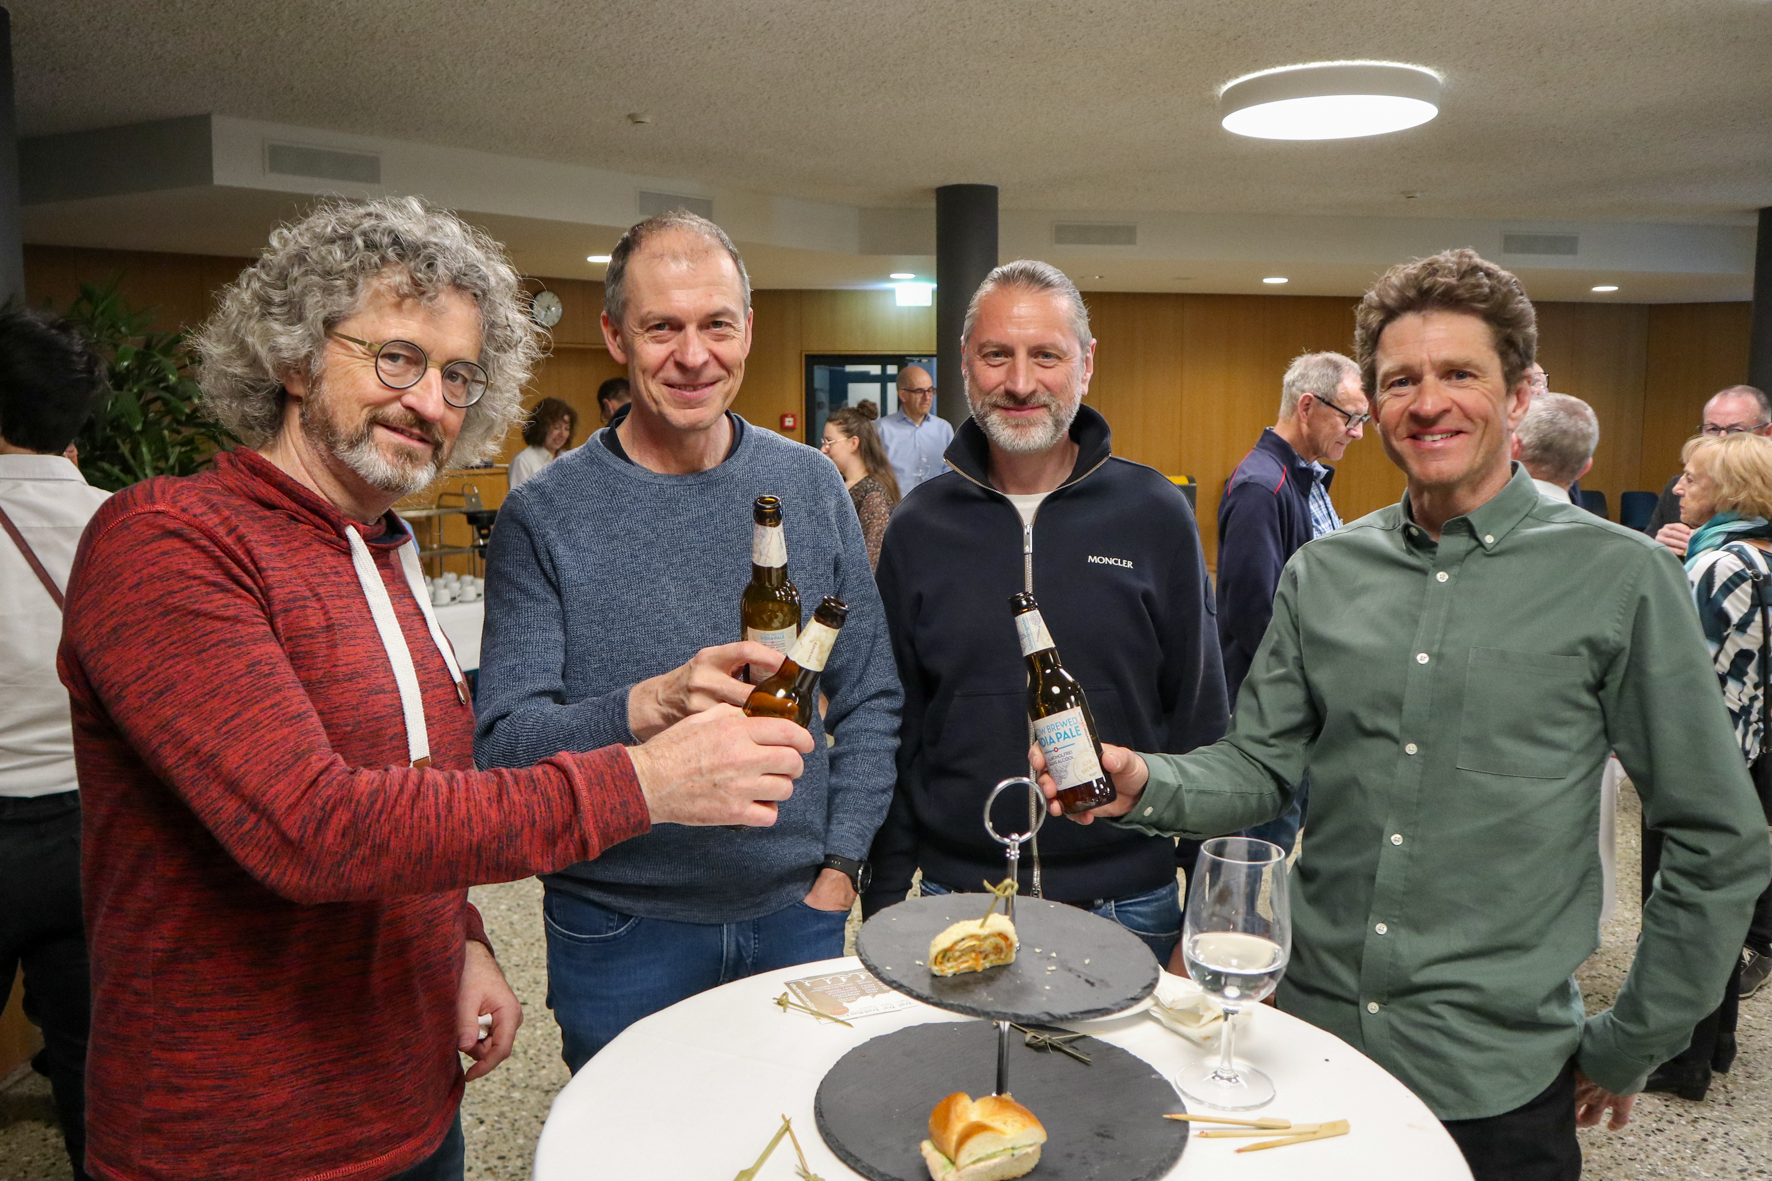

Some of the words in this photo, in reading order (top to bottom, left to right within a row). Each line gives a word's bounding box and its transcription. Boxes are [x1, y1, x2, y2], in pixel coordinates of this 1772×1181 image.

[1087, 555, 1134, 569] MONCLER
[1047, 716, 1078, 733] BREWED
[1055, 725, 1082, 742] PALE
[1057, 755, 1075, 764] ALCOOL
